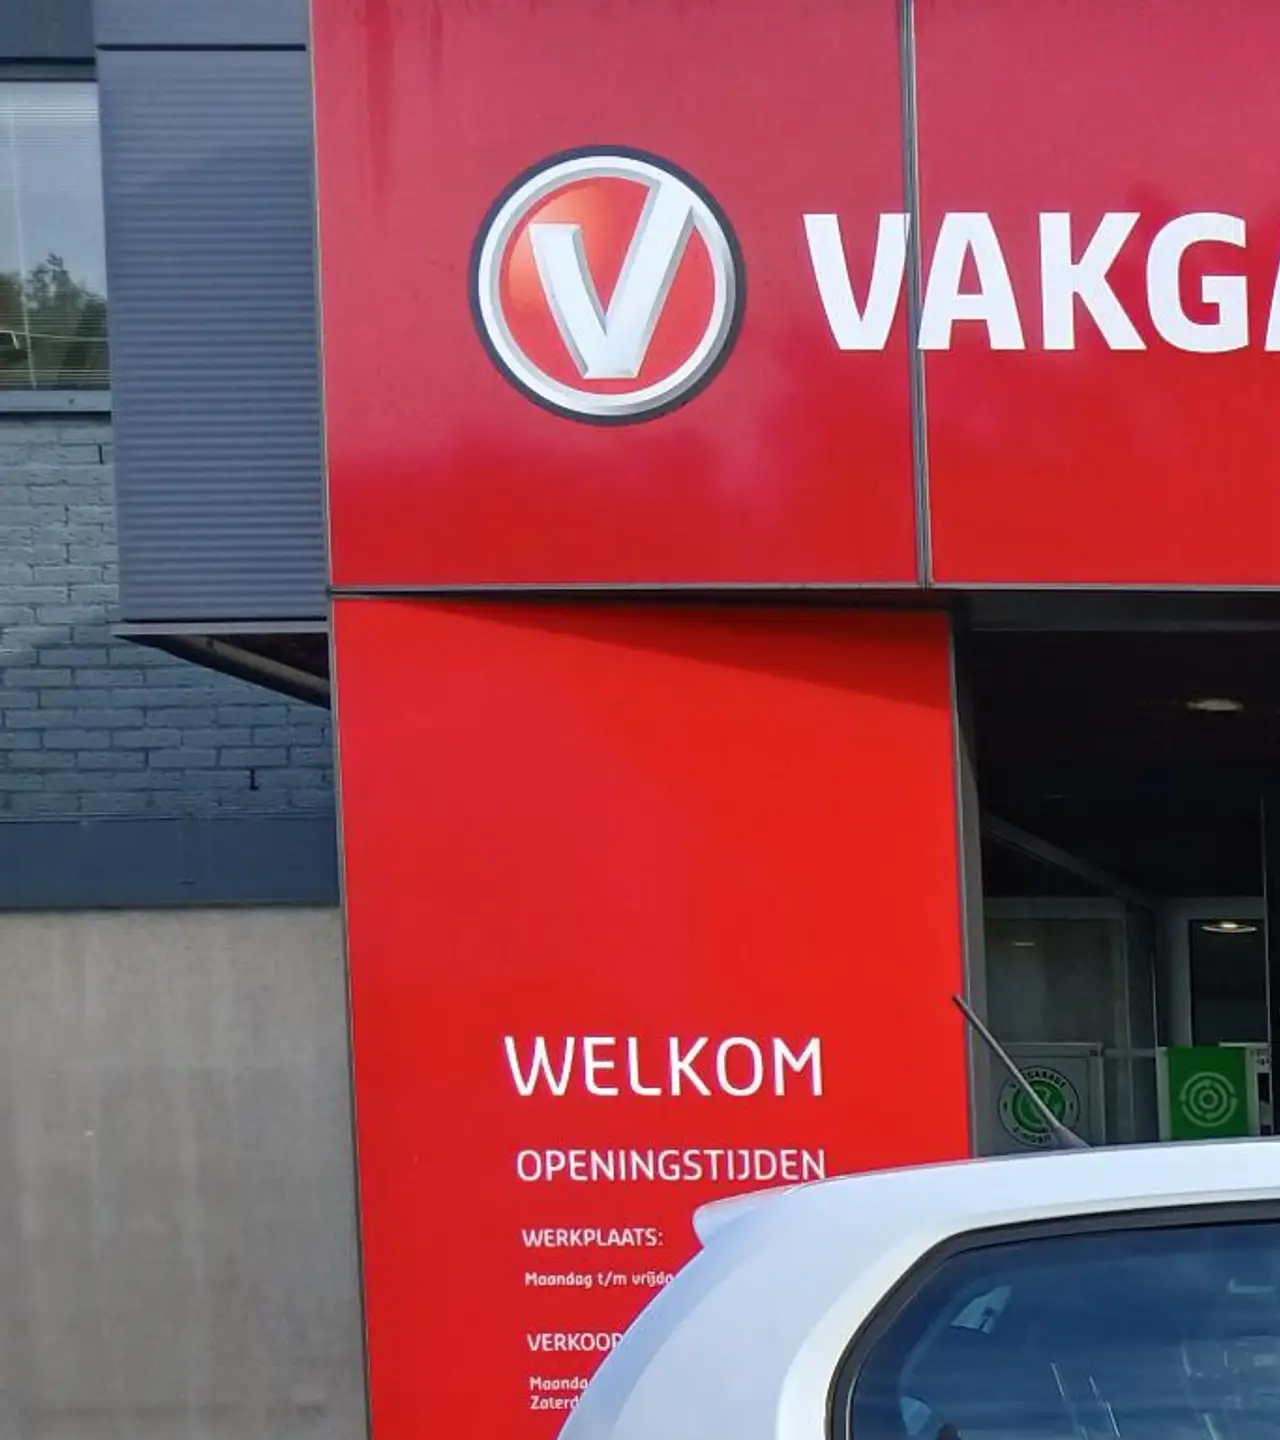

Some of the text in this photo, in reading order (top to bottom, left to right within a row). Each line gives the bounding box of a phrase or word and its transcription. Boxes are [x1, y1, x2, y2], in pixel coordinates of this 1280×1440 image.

[504, 1036, 823, 1096] WELKOM
[517, 1149, 827, 1182] OPENINGSTIJDEN
[522, 1228, 664, 1247] WERKPLAATS:
[524, 1272, 593, 1289] Maandag
[597, 1271, 627, 1286] t/m
[529, 1376, 589, 1391] Maanda
[530, 1395, 581, 1410] Zaterd
